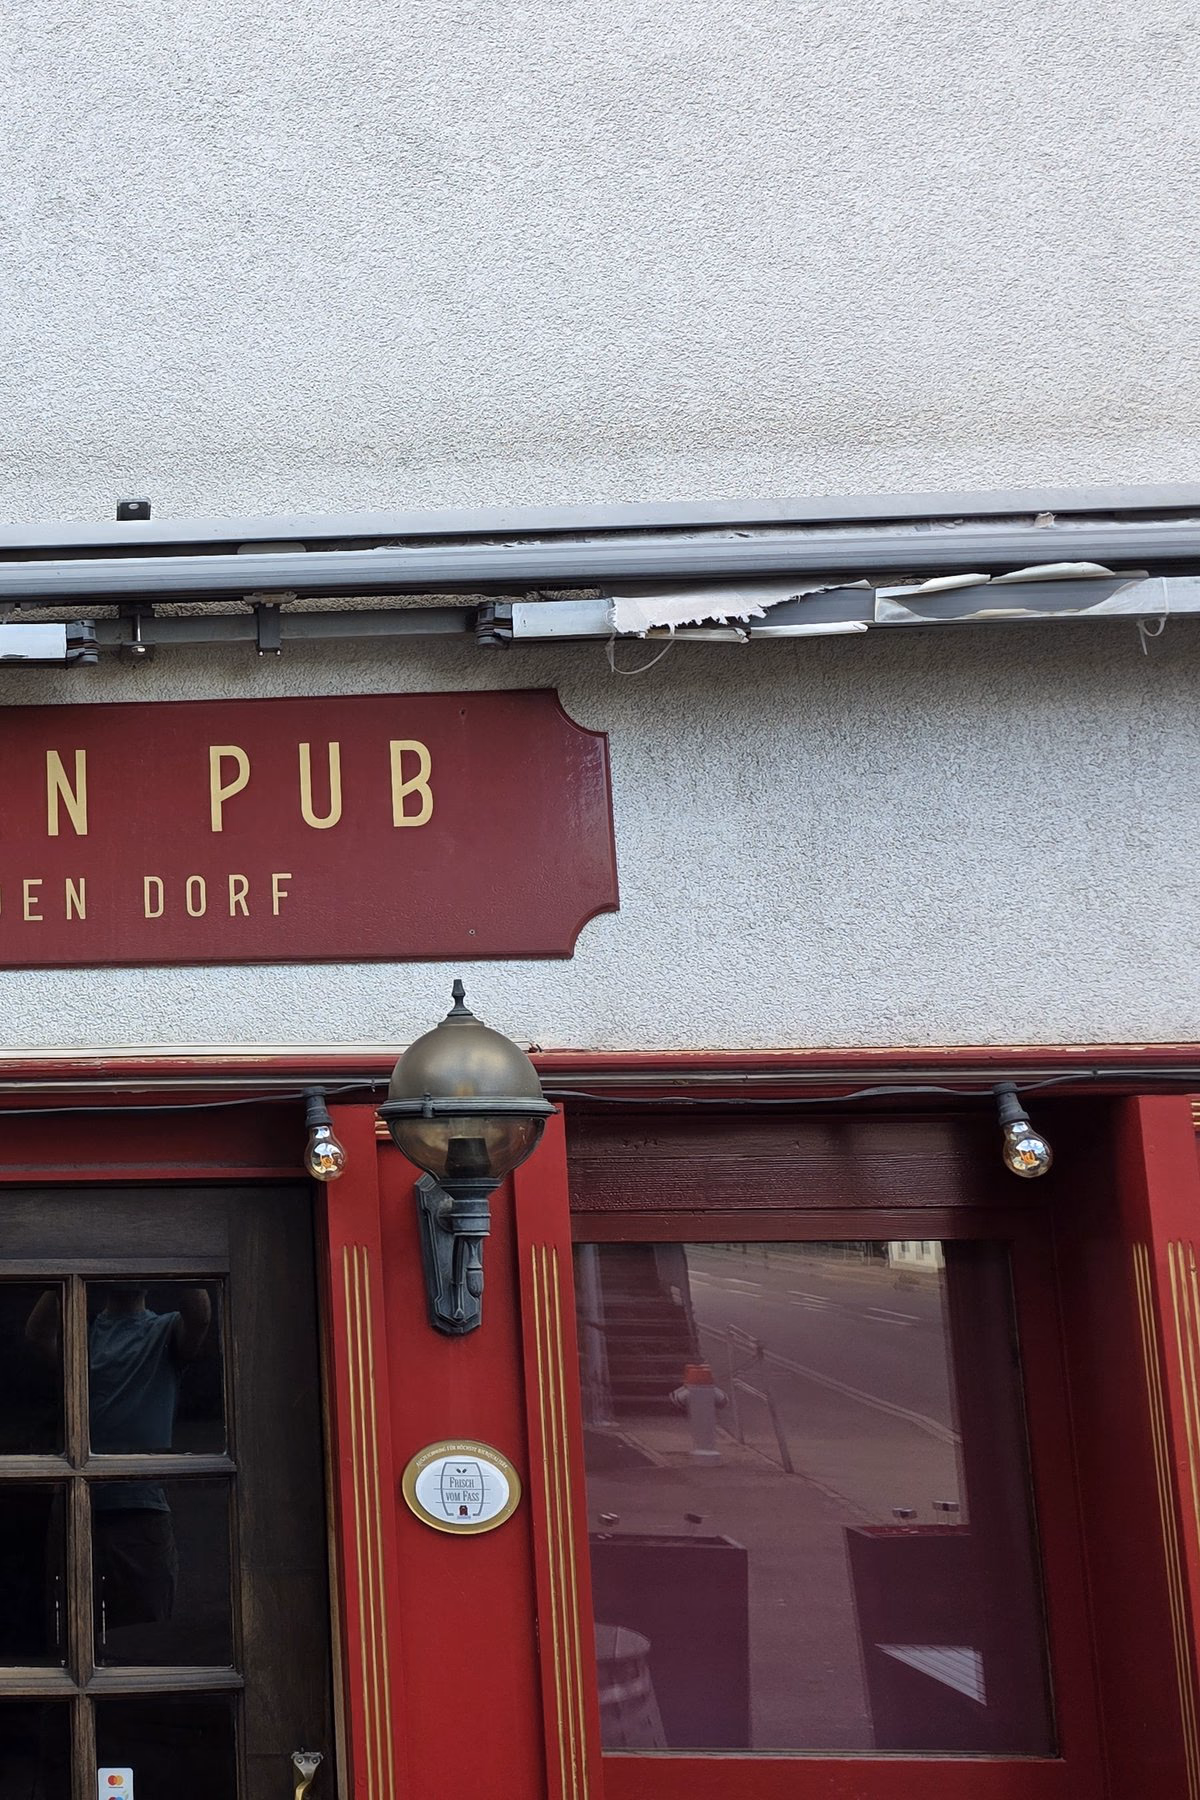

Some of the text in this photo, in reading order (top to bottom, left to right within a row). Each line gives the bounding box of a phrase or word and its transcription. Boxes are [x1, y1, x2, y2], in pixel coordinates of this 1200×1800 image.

[209, 739, 435, 832] PUB
[143, 872, 292, 919] DORF
[449, 1477, 474, 1488] FRISCH
[462, 1490, 480, 1502] FASS
